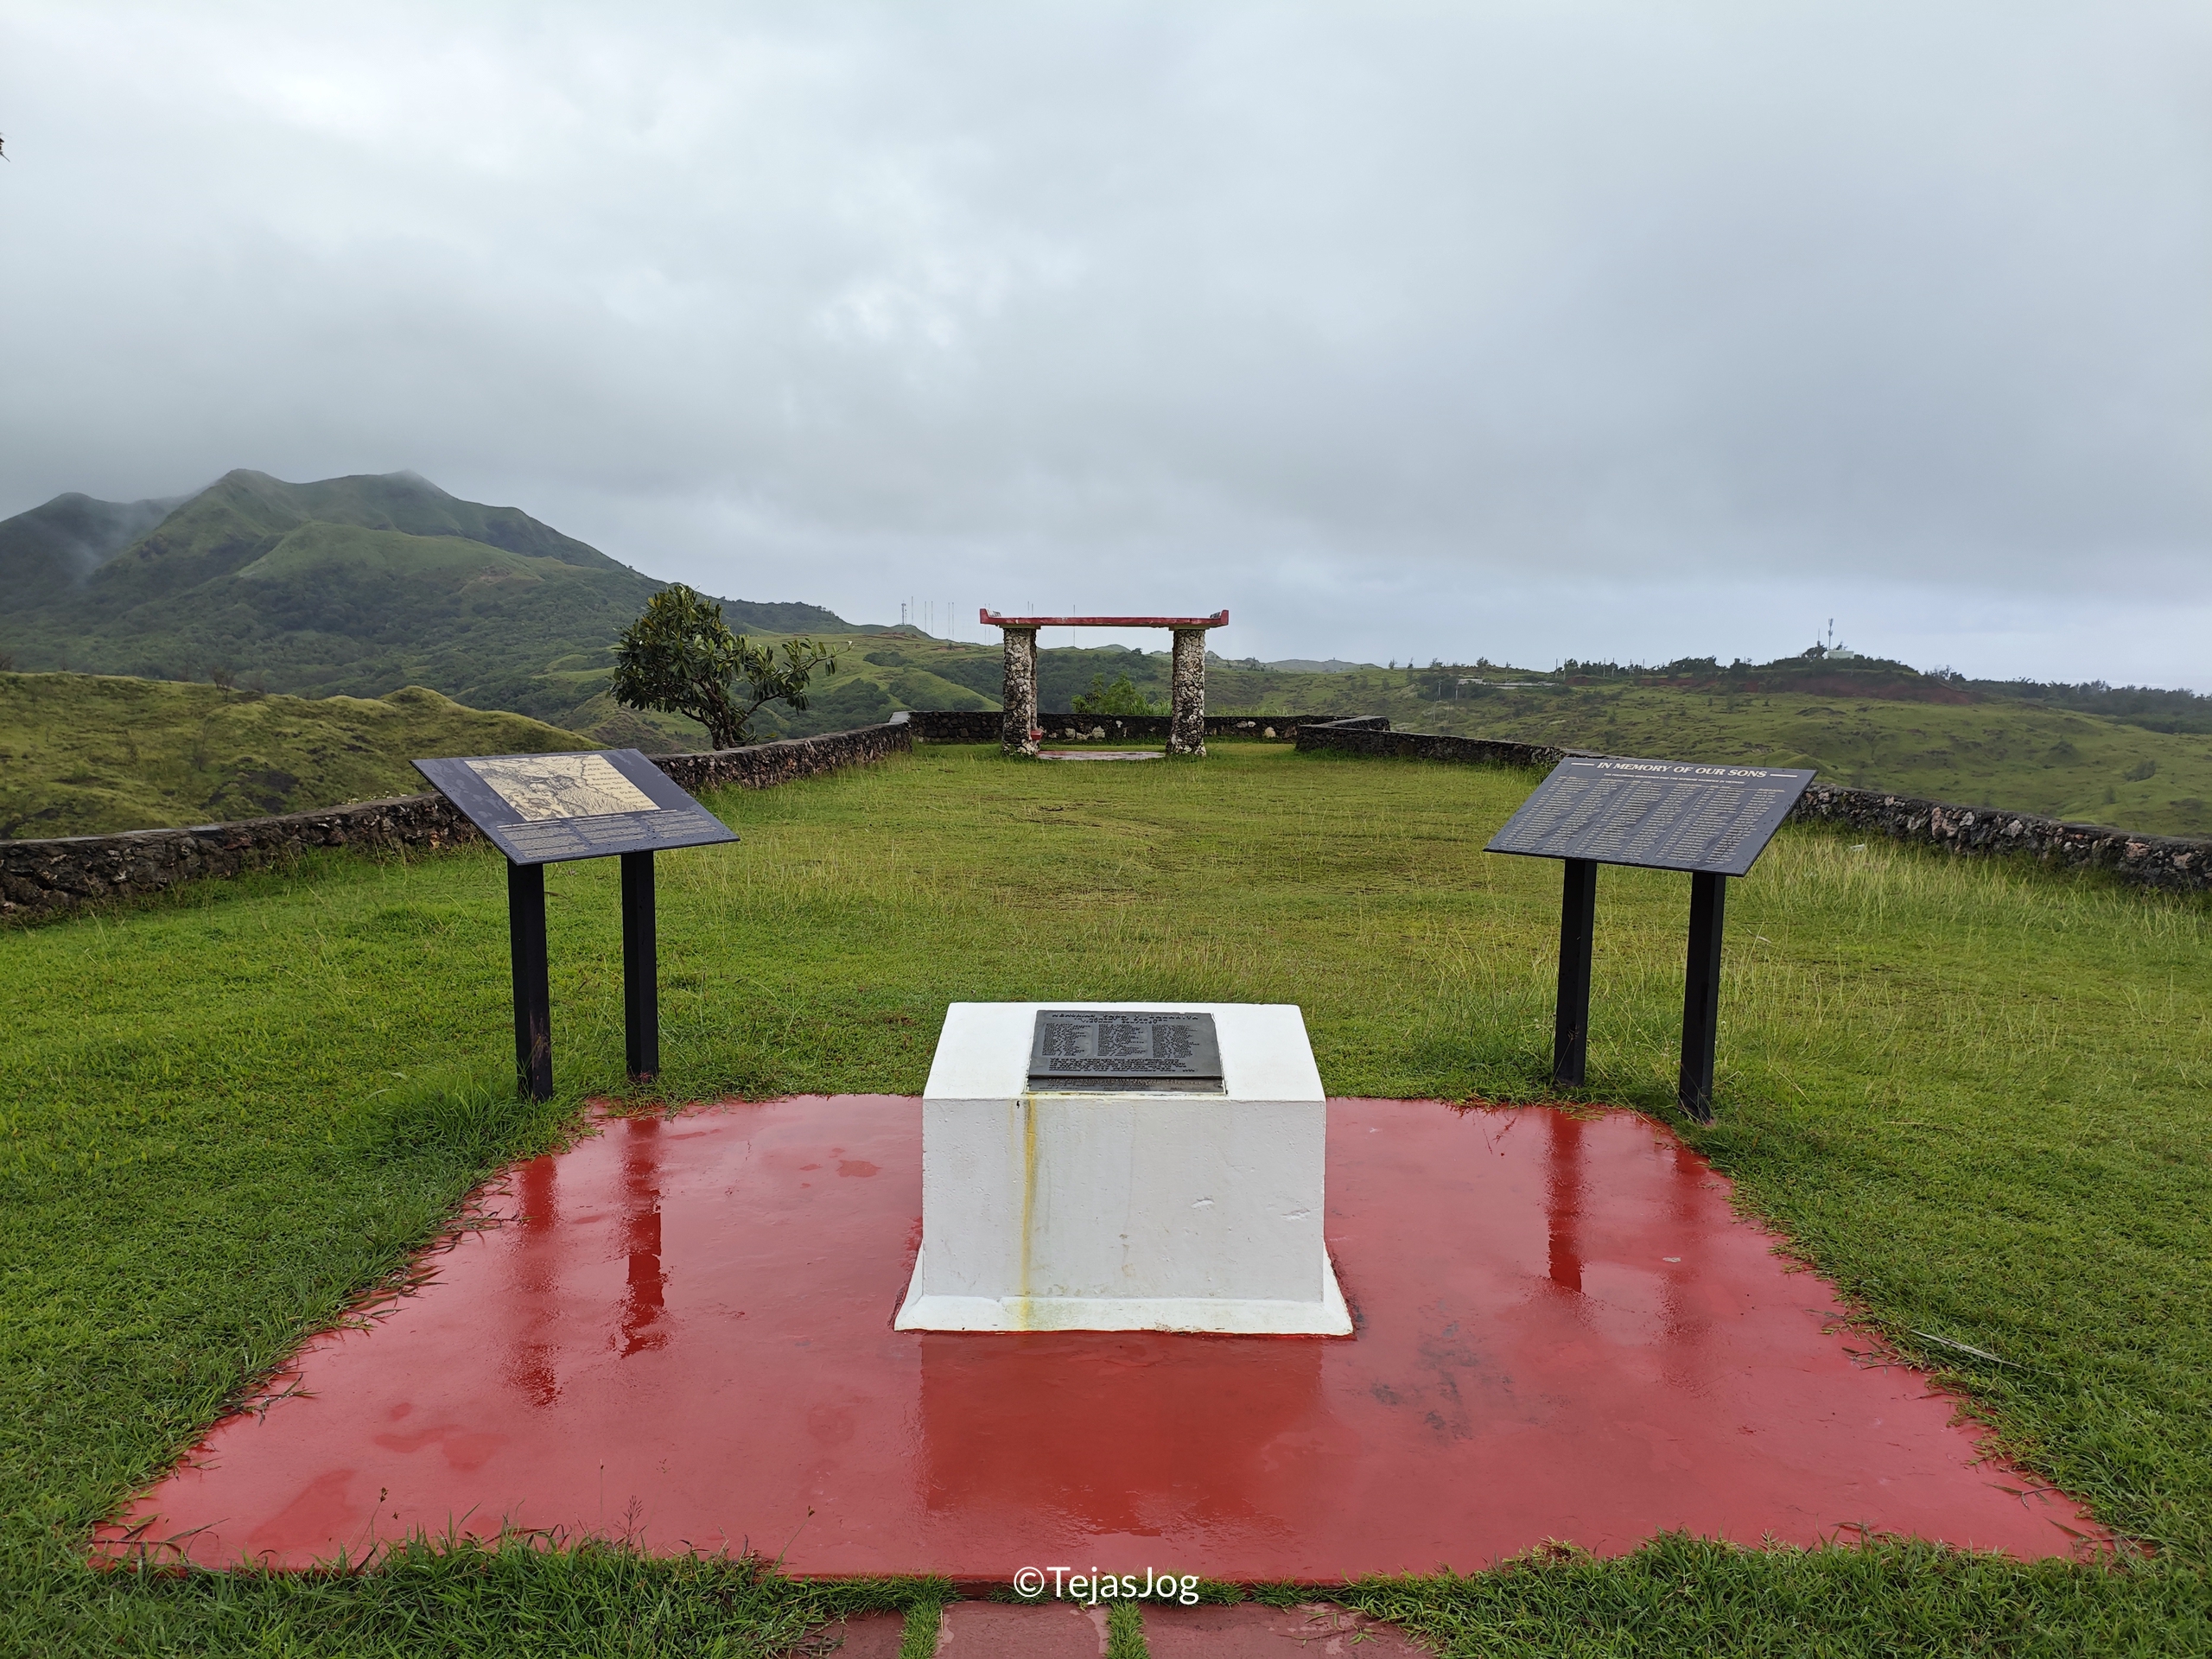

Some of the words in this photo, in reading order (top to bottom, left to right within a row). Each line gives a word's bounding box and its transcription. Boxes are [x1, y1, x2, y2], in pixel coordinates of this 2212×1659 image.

[1613, 762, 1672, 772] MEMORY
[1694, 767, 1725, 776] OUR
[1727, 769, 1767, 778] SONS
